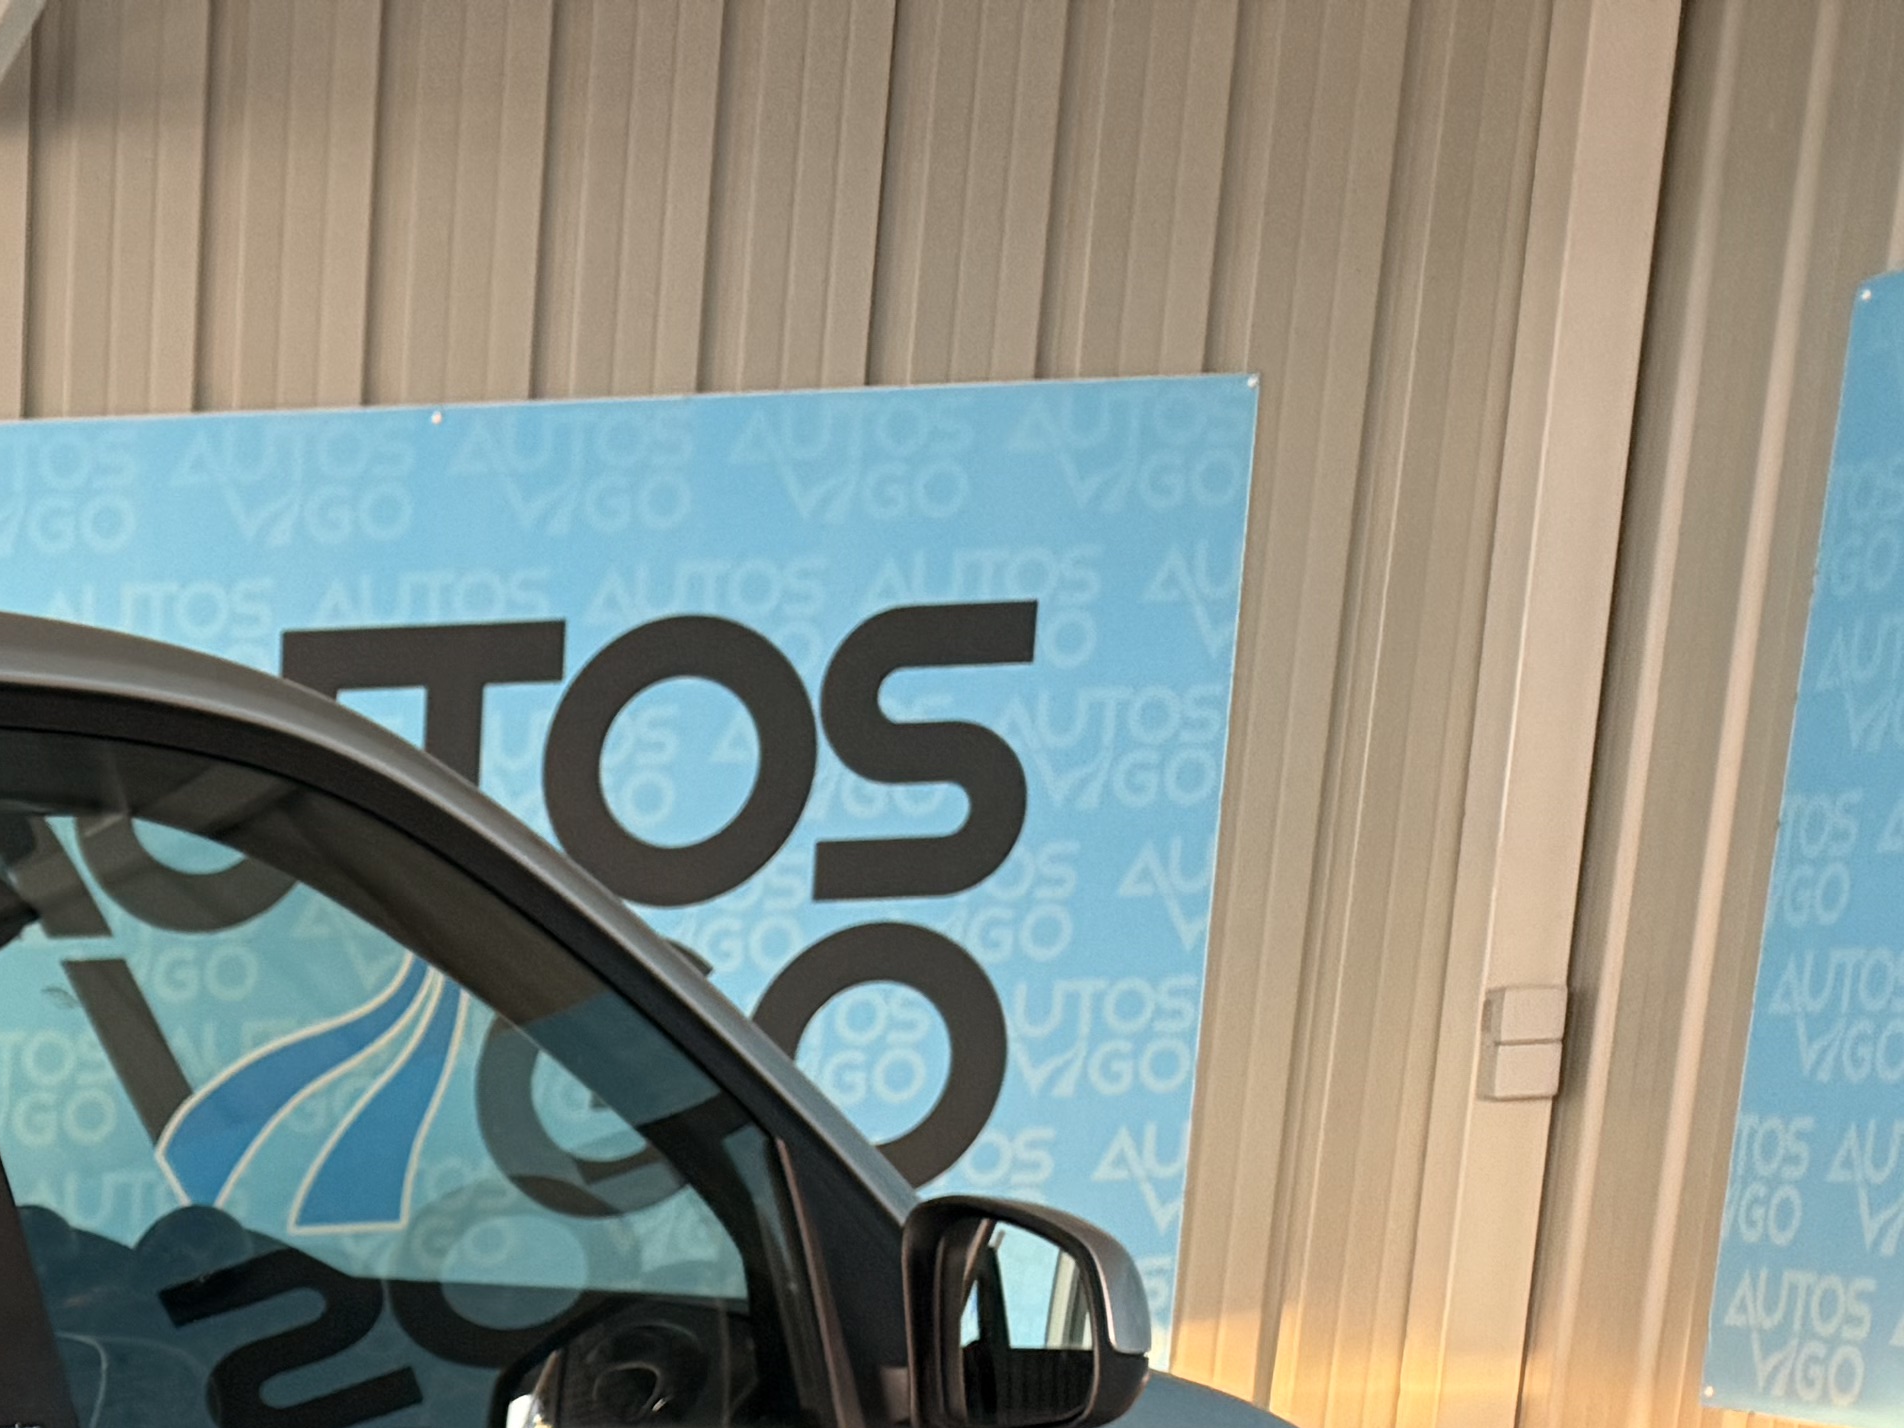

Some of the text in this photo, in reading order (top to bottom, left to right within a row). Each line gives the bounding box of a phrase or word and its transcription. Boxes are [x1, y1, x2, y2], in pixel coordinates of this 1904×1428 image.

[169, 418, 417, 487] AUTOS
[447, 408, 694, 476] AUTOS
[728, 396, 975, 465] AUTOS
[1012, 976, 1196, 1046] UTOS
[1723, 1266, 1878, 1342] AUTOS
[1752, 1338, 1865, 1408] VIGO
